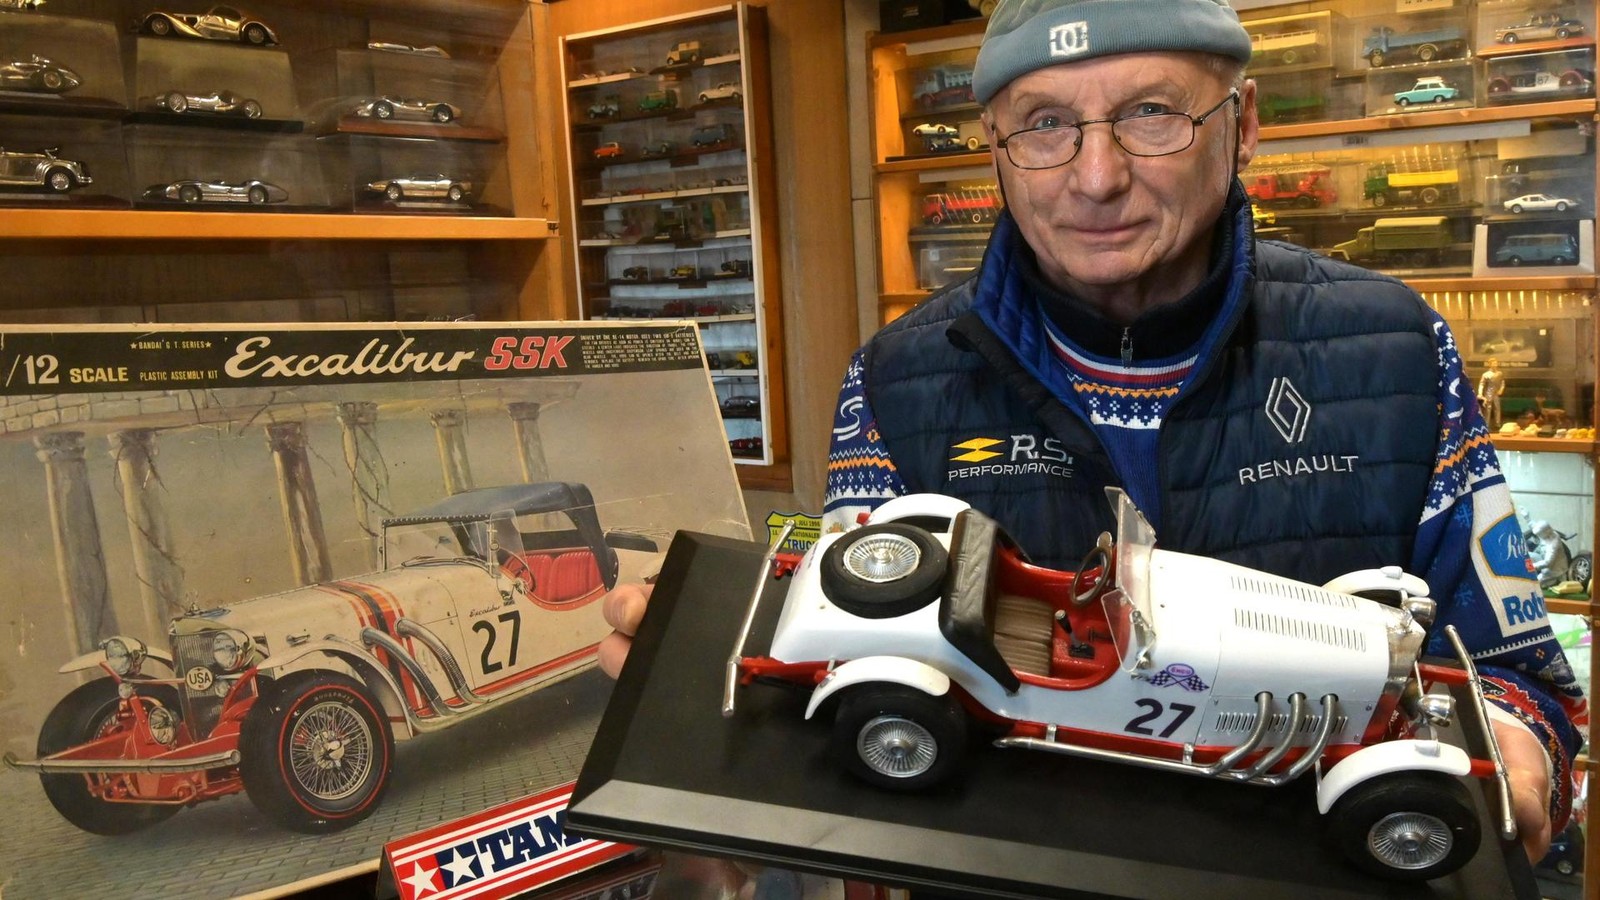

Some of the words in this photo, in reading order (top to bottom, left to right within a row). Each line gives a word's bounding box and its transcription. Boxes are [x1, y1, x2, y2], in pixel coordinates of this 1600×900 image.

[182, 341, 205, 349] SERIES
[224, 336, 476, 379] Excalibur
[484, 335, 575, 371] SSK
[69, 367, 129, 384] SCALE
[139, 372, 167, 381] PLASTIC
[171, 371, 204, 380] ASSEMBLY
[207, 370, 218, 379] KIT
[948, 462, 1074, 481] PERFORMANCE
[1239, 455, 1359, 485] RENAULT
[787, 539, 815, 550] TRUC
[472, 610, 521, 675] 27
[189, 672, 212, 685] USA
[1124, 698, 1196, 738] 27
[476, 808, 586, 873] TAM
